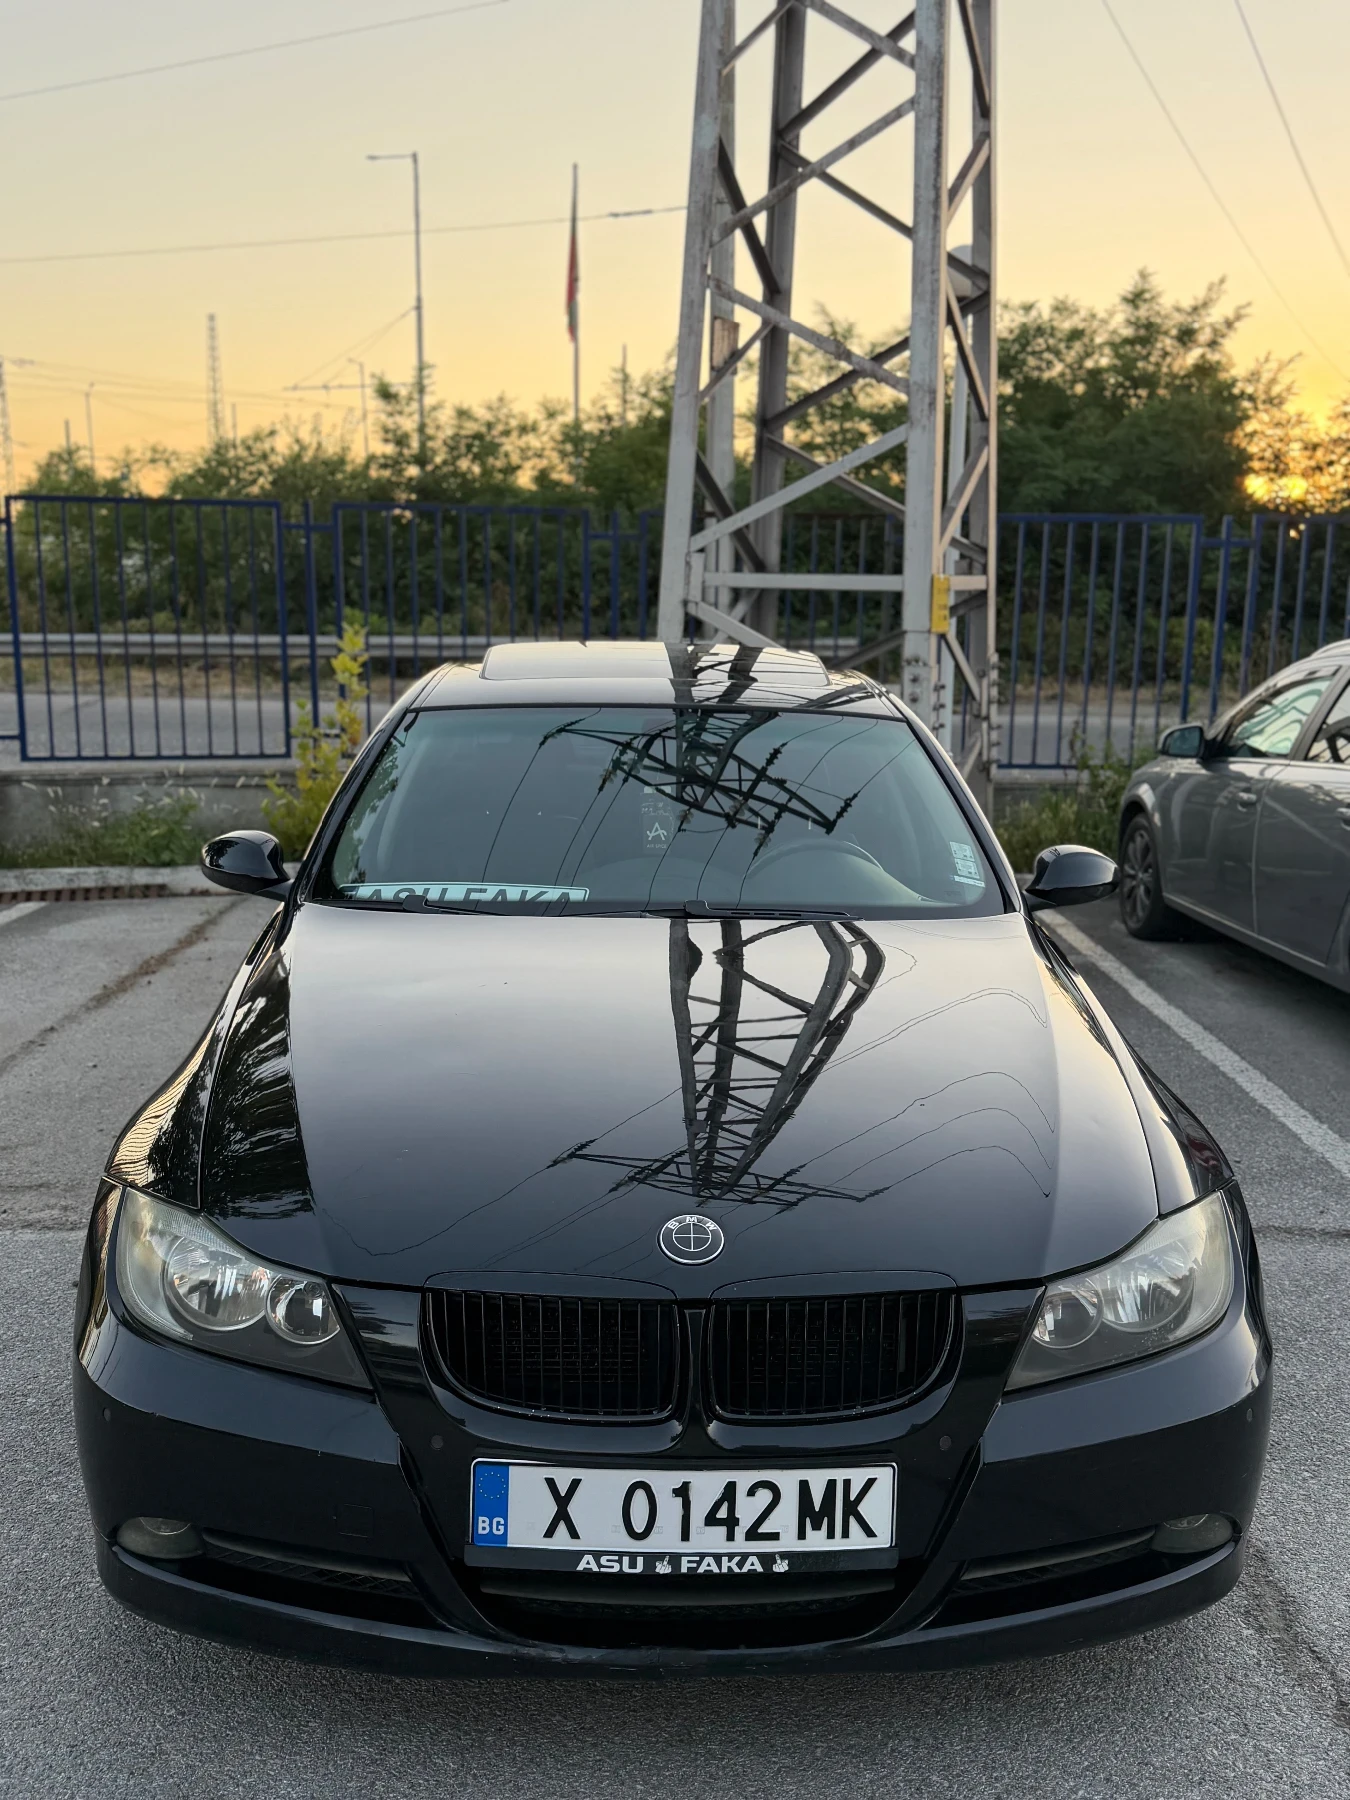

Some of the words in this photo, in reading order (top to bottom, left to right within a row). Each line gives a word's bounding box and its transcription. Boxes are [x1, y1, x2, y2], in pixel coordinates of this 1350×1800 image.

[667, 1216, 717, 1230] BMW
[542, 1477, 583, 1540] X
[477, 1516, 505, 1535] BG
[576, 1554, 644, 1574] ASU
[680, 1555, 764, 1574] FAKA
